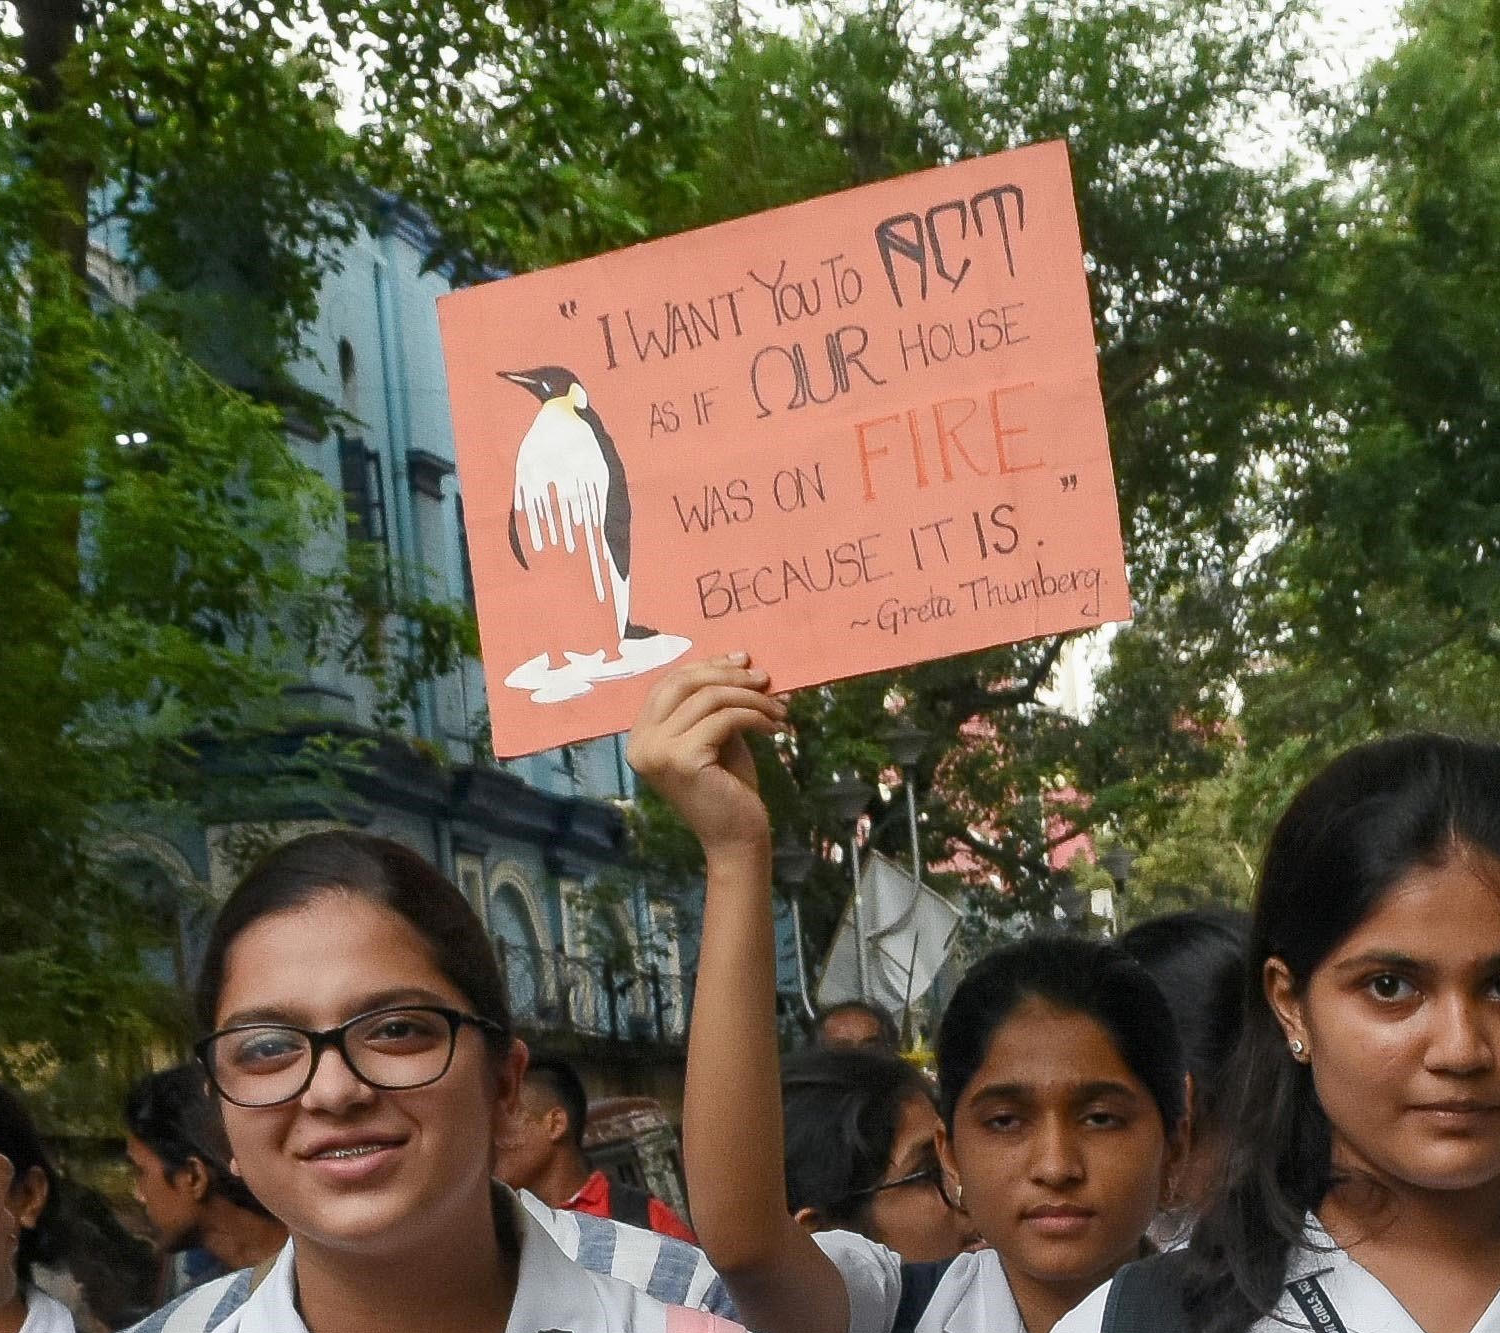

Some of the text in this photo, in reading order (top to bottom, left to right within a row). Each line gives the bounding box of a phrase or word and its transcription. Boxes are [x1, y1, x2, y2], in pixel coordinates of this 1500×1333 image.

[630, 289, 746, 362] WANT
[875, 184, 1026, 308] ACT
[649, 302, 1031, 440] AS IF OUR HOUSE
[673, 381, 1045, 534] WAS ON FIRE
[695, 533, 895, 621] BECAUSE
[908, 517, 954, 571] IT
